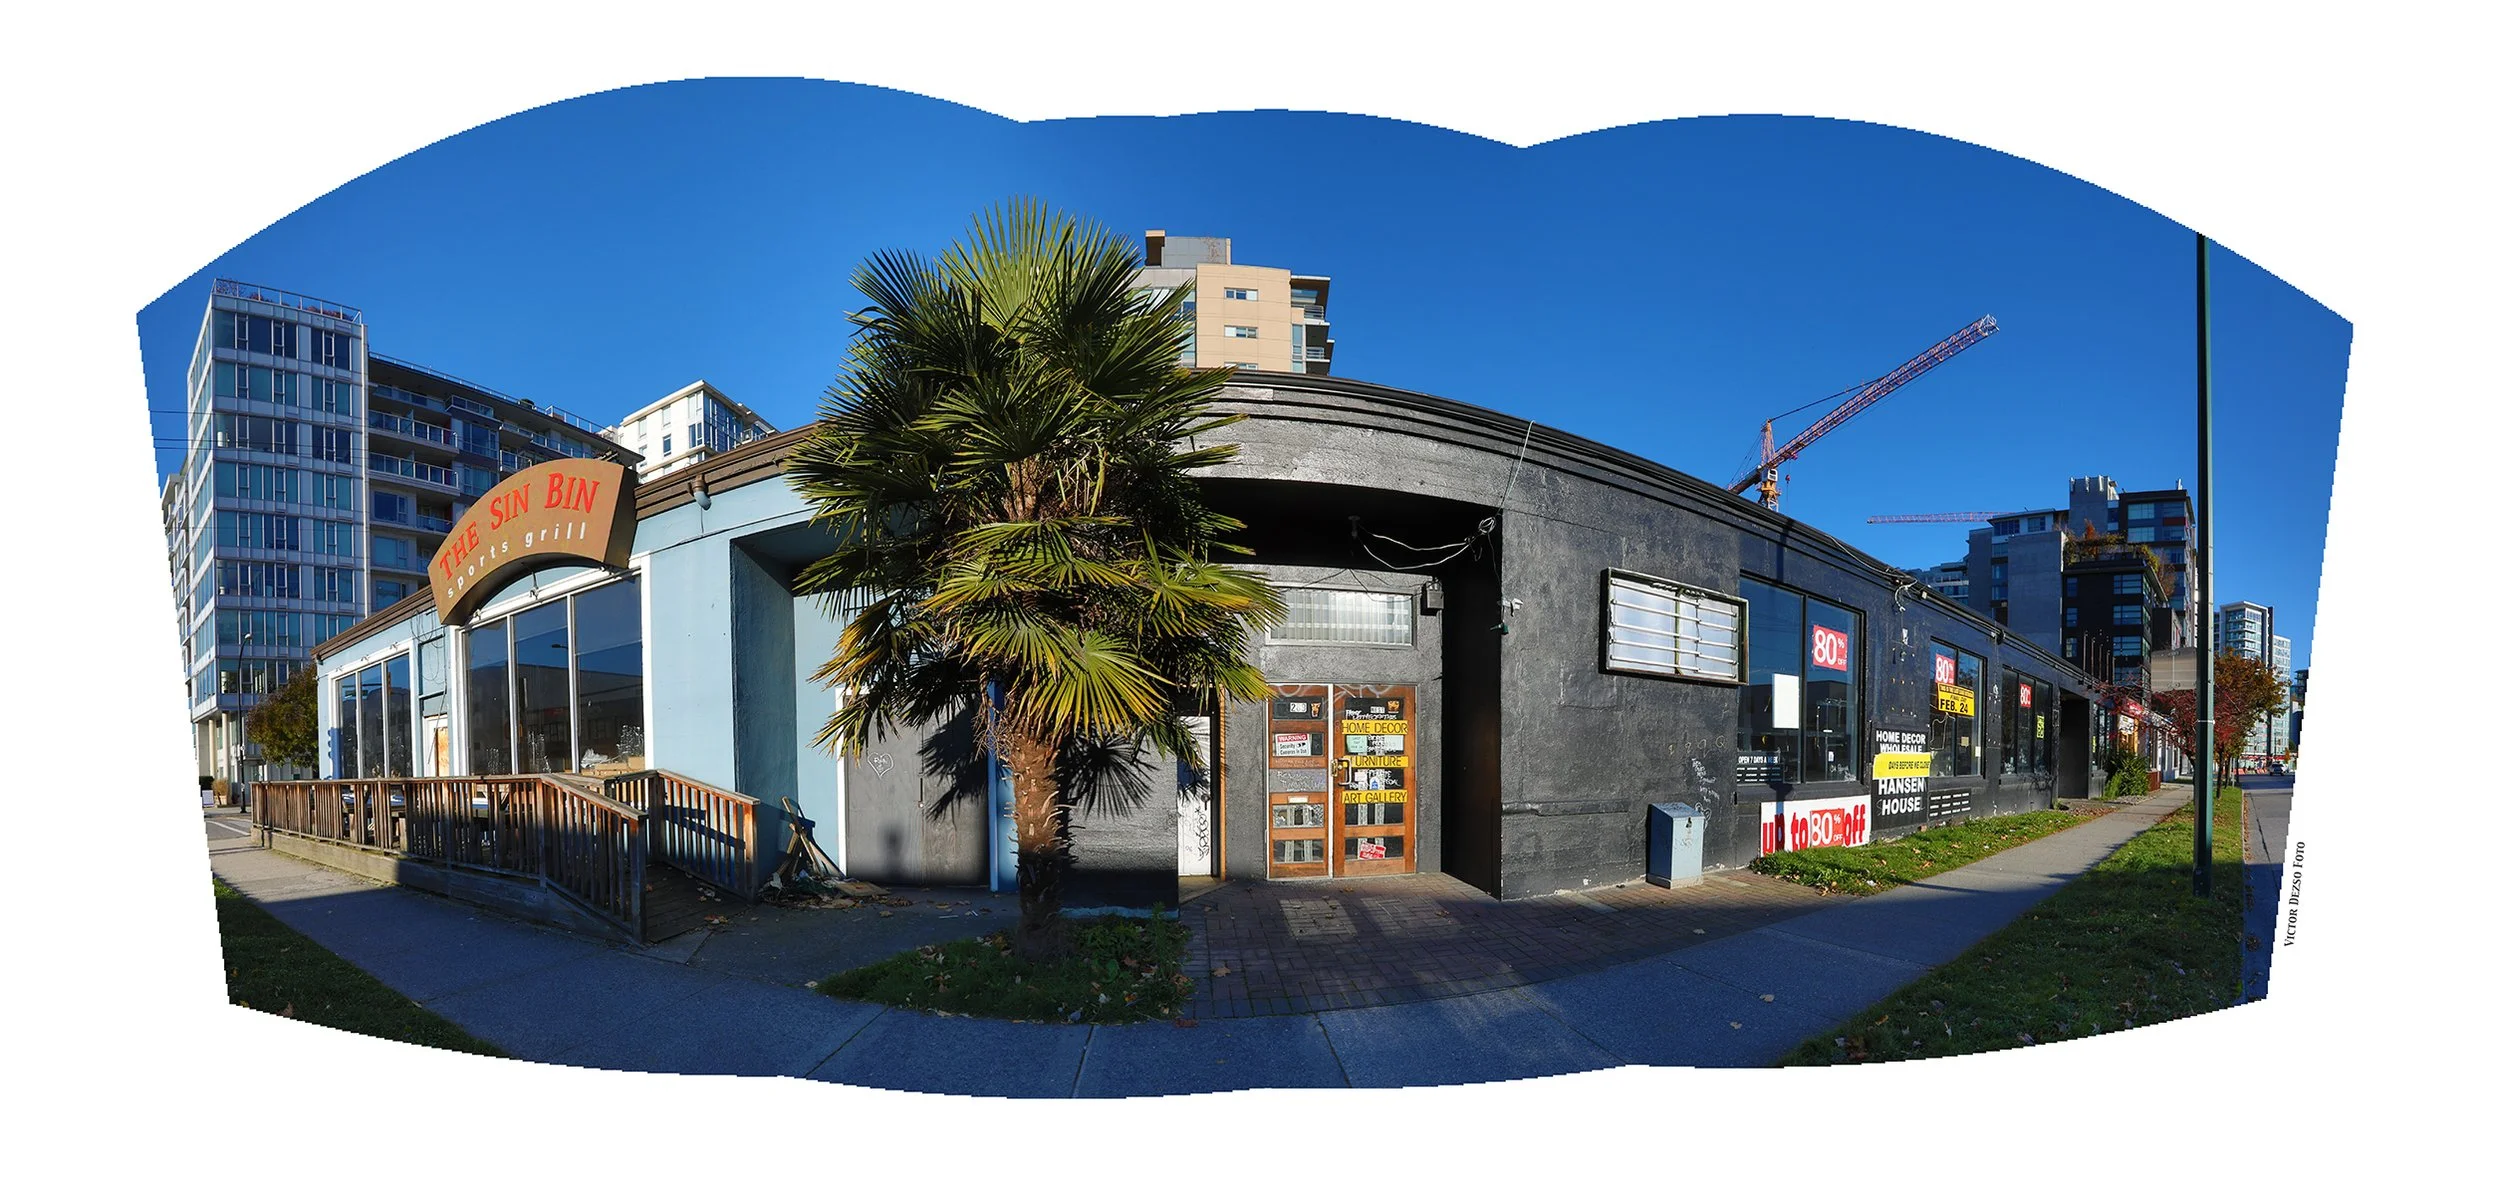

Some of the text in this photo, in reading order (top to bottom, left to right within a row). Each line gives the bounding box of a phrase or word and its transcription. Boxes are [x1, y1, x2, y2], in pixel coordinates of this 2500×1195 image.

[439, 472, 600, 580] THE SIN BIN
[447, 521, 586, 598] sports grill
[1940, 699, 1957, 711] FEB.
[1342, 722, 1408, 734] HOME DECOR
[1278, 734, 1307, 742] WARNING
[1875, 730, 1926, 745] HOME DECOR
[1880, 743, 1923, 753] WHOLESALE
[1738, 756, 1750, 764] OPEN
[1878, 777, 1925, 796] HANSEN
[1344, 791, 1407, 804] ART GALLERY
[1881, 796, 1922, 816] HOUSE
[1791, 812, 1809, 853] to
[1844, 804, 1866, 846] off
